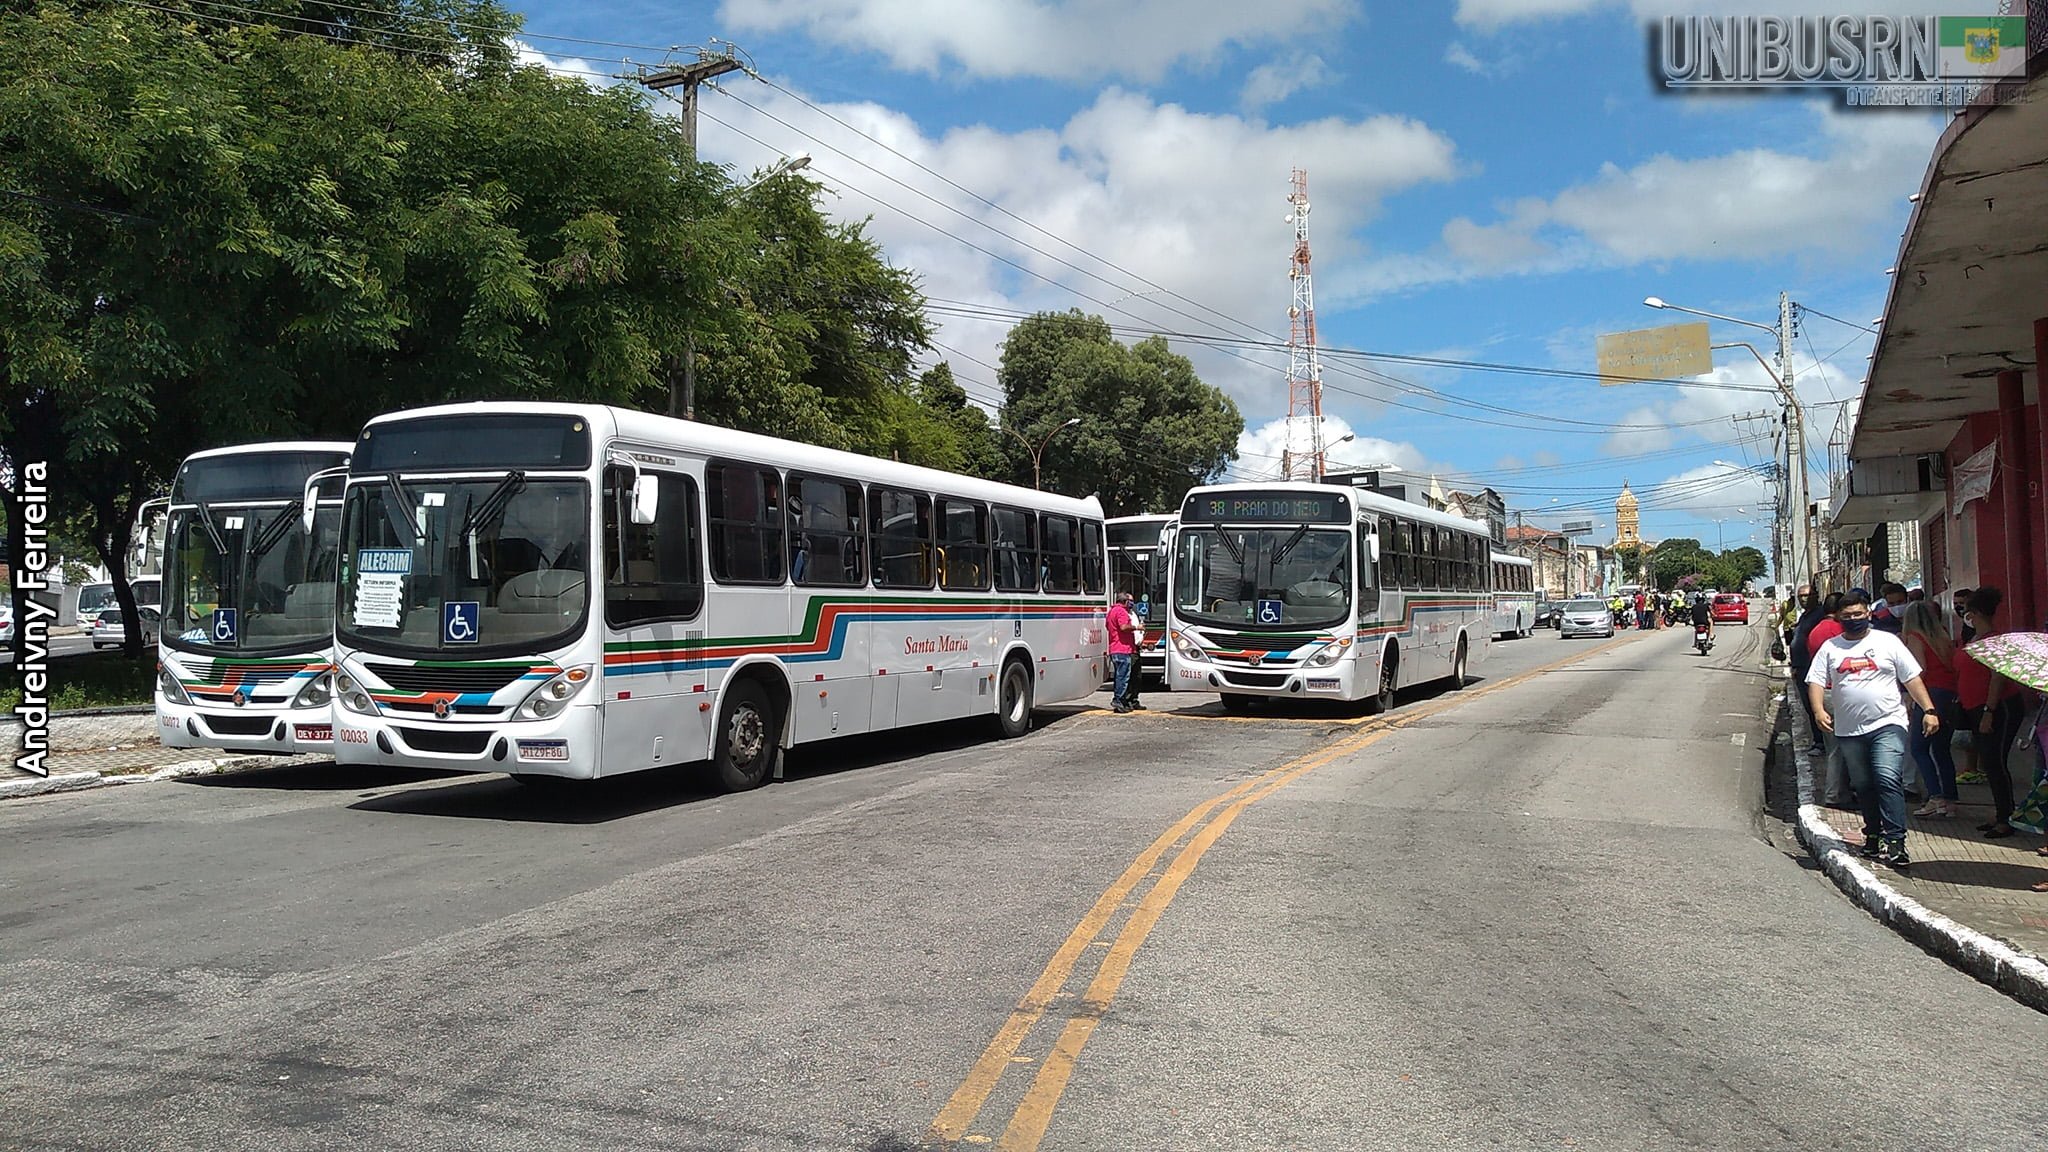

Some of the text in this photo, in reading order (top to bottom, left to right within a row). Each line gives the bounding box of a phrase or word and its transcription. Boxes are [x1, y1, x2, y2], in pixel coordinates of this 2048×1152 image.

[1209, 501, 1320, 516] 38 PRAIA DO MEIO
[360, 552, 410, 571] ALECRIM
[904, 634, 969, 655] Santa Maria
[1180, 669, 1202, 680] 02115
[340, 729, 368, 744] 02033
